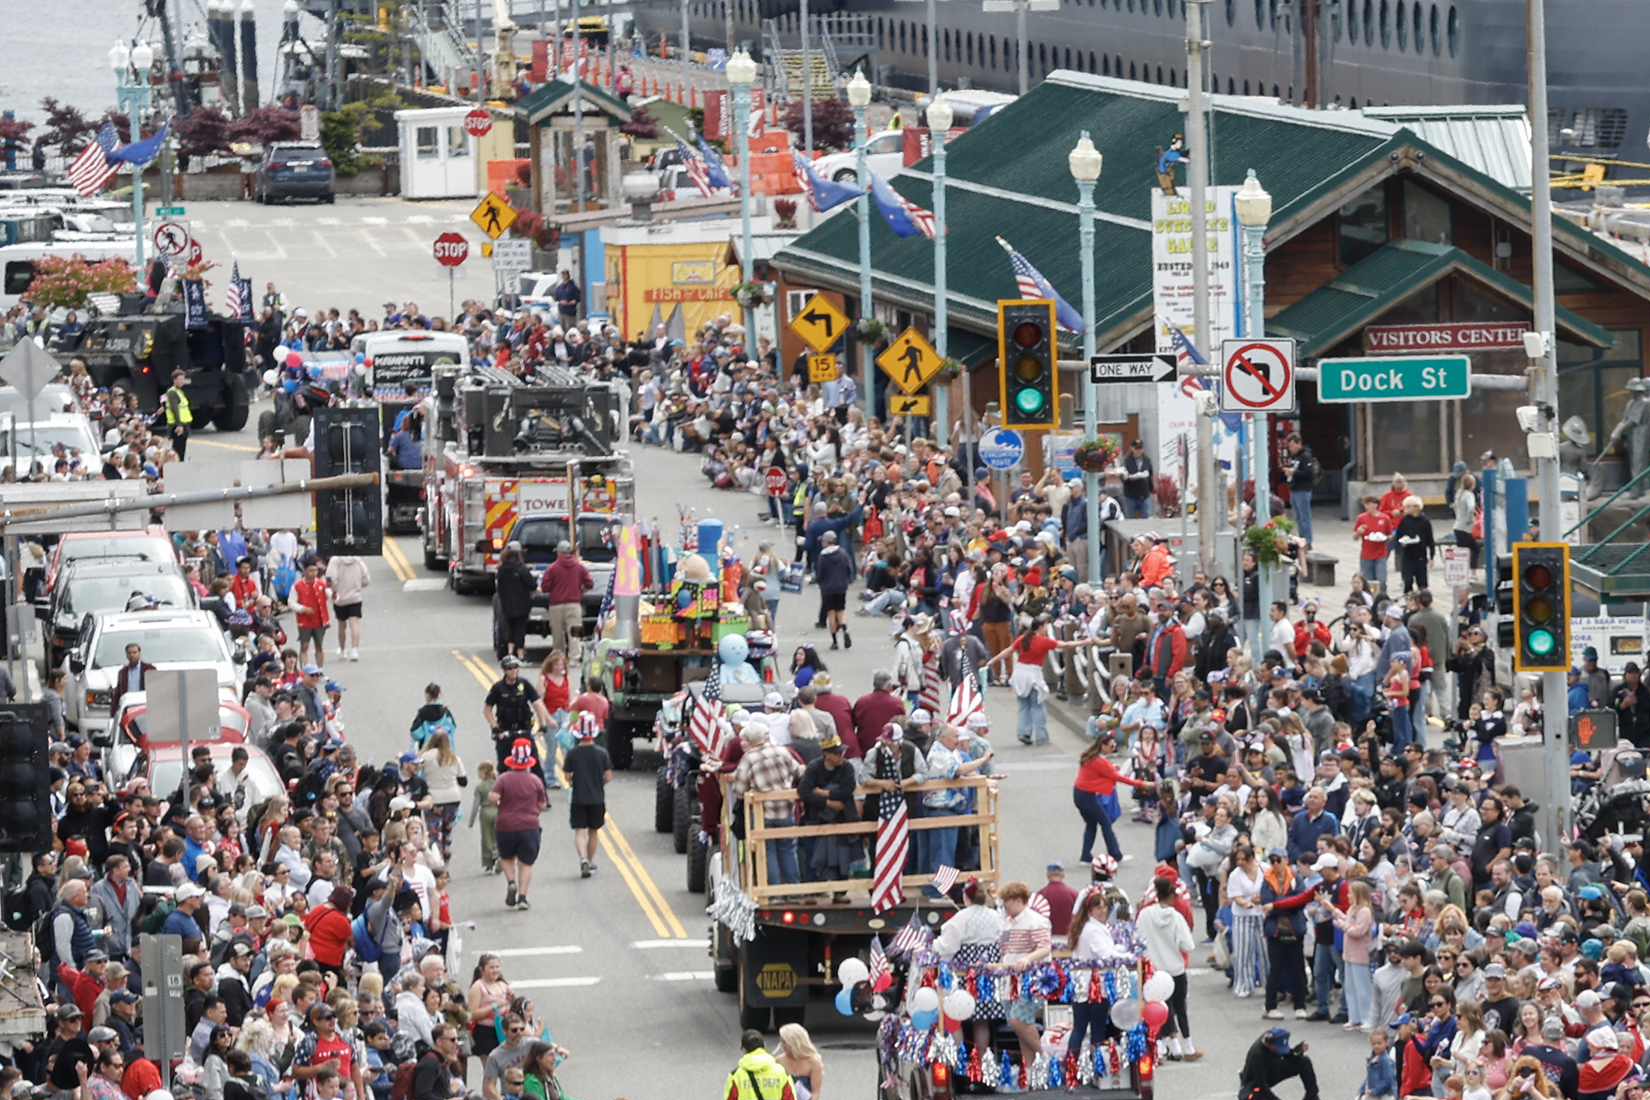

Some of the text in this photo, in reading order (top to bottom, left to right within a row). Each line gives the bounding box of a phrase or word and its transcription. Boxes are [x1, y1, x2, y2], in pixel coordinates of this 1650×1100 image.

[466, 117, 491, 130] STOP
[1167, 201, 1214, 214] LIQD
[434, 241, 467, 258] STOP
[652, 286, 681, 300] FISH
[698, 285, 733, 300] CHIP
[1368, 327, 1527, 346] VISITORS CENTER
[814, 358, 830, 372] 15
[1099, 363, 1154, 376] ONE WAY
[1341, 367, 1448, 392] Dock St
[524, 498, 570, 511] TOWE
[763, 971, 792, 989] NAPA
